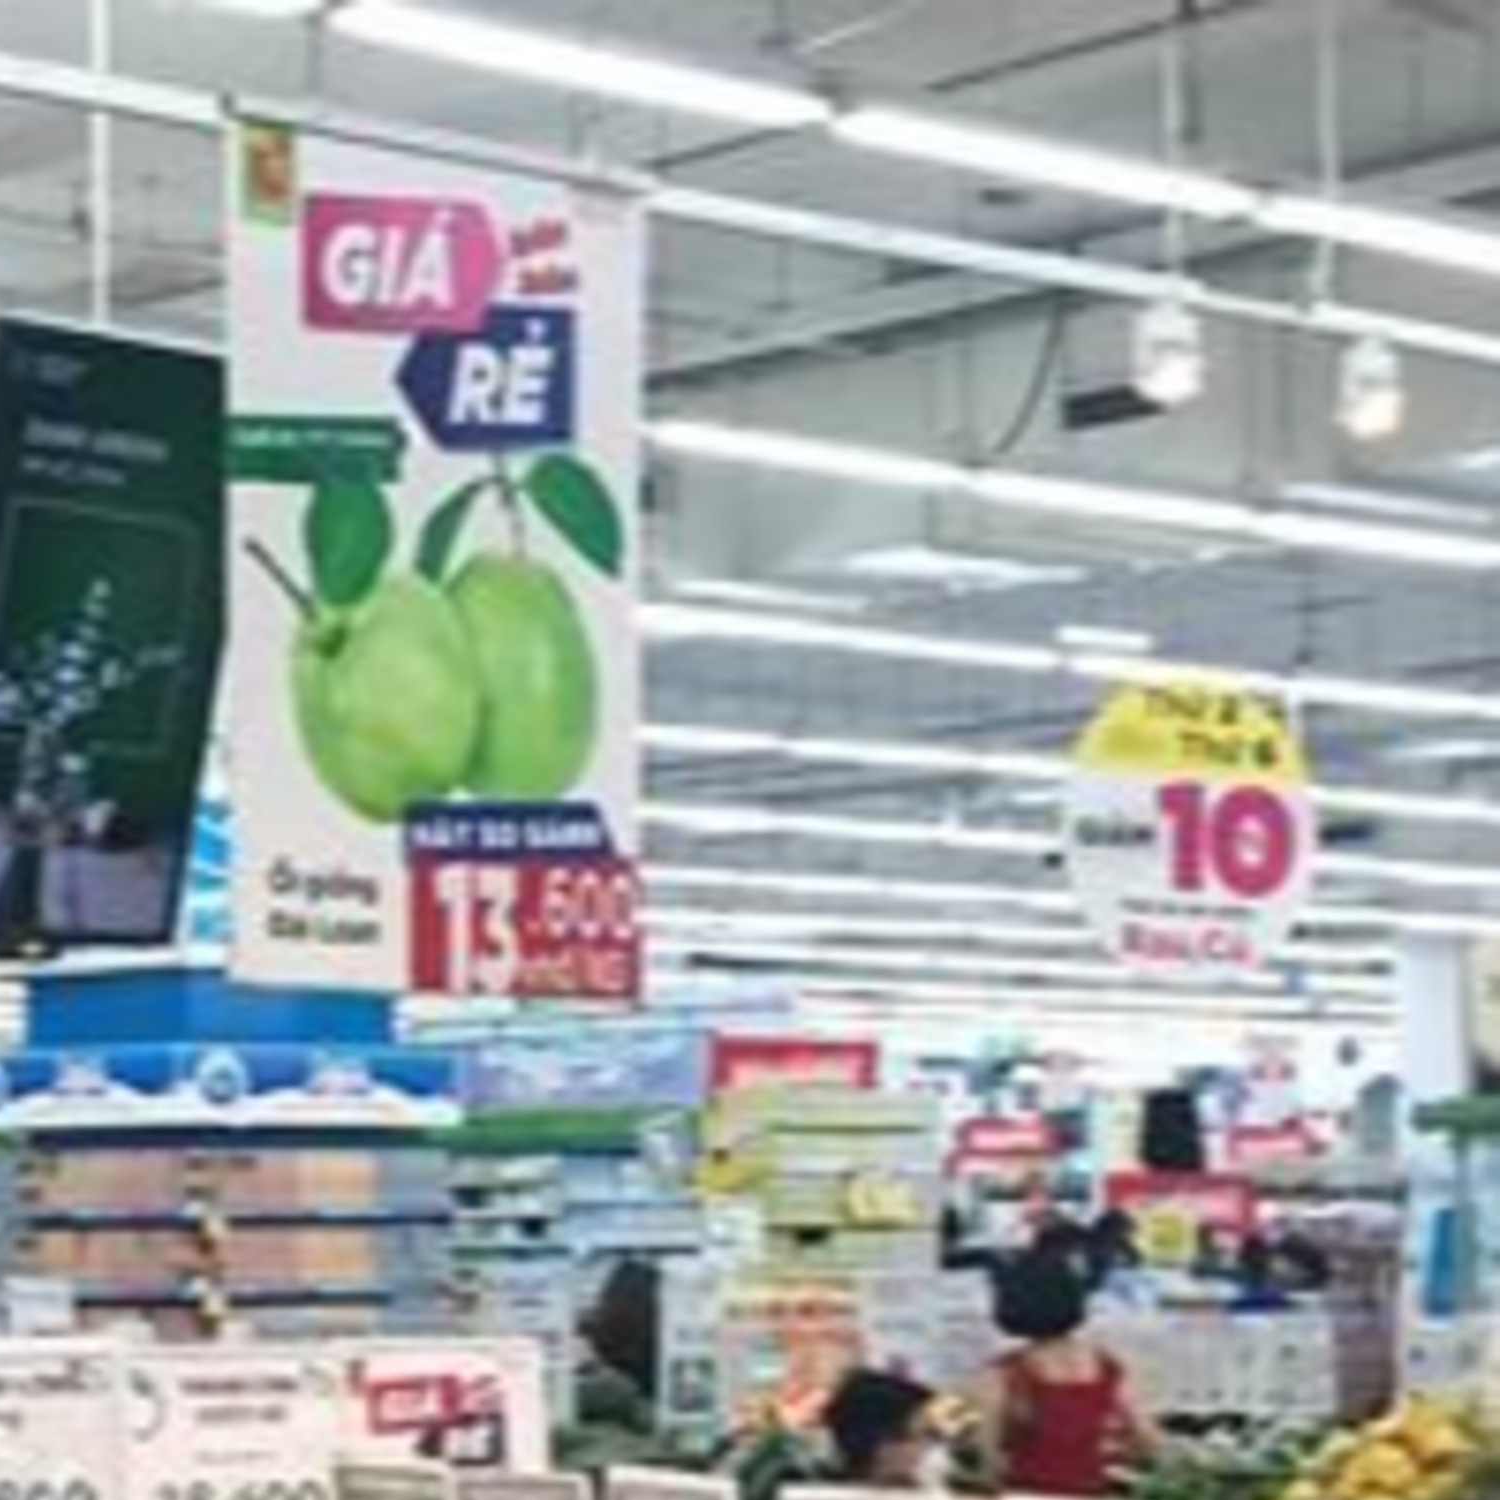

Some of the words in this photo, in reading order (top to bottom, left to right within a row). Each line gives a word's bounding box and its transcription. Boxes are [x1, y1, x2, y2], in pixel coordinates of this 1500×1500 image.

[320, 209, 453, 310] GIÁ
[448, 318, 555, 425] RẺ
[1158, 783, 1295, 898] 10
